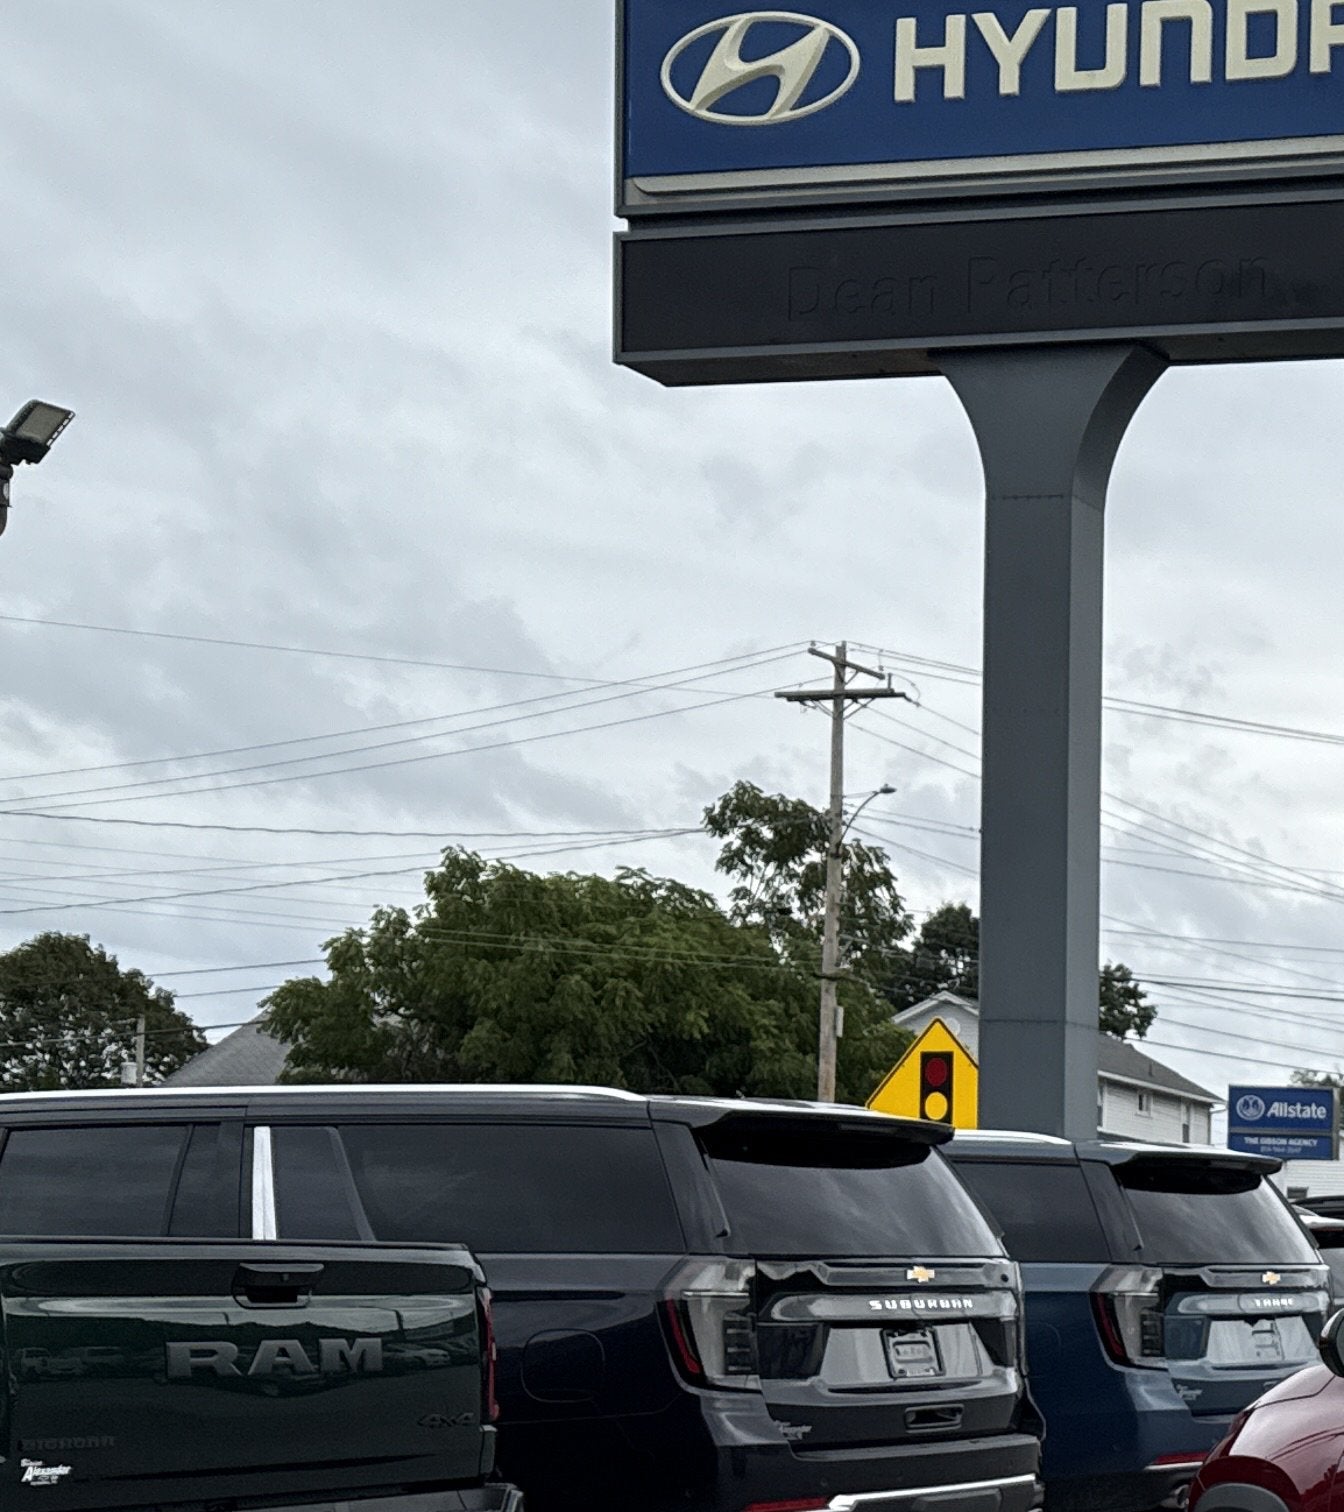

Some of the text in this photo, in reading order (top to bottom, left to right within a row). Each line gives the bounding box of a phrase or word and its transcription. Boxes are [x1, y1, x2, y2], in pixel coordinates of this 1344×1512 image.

[1266, 1101, 1327, 1119] Allstate
[868, 1298, 974, 1311] SUBURBAN
[166, 1337, 383, 1379] RAM
